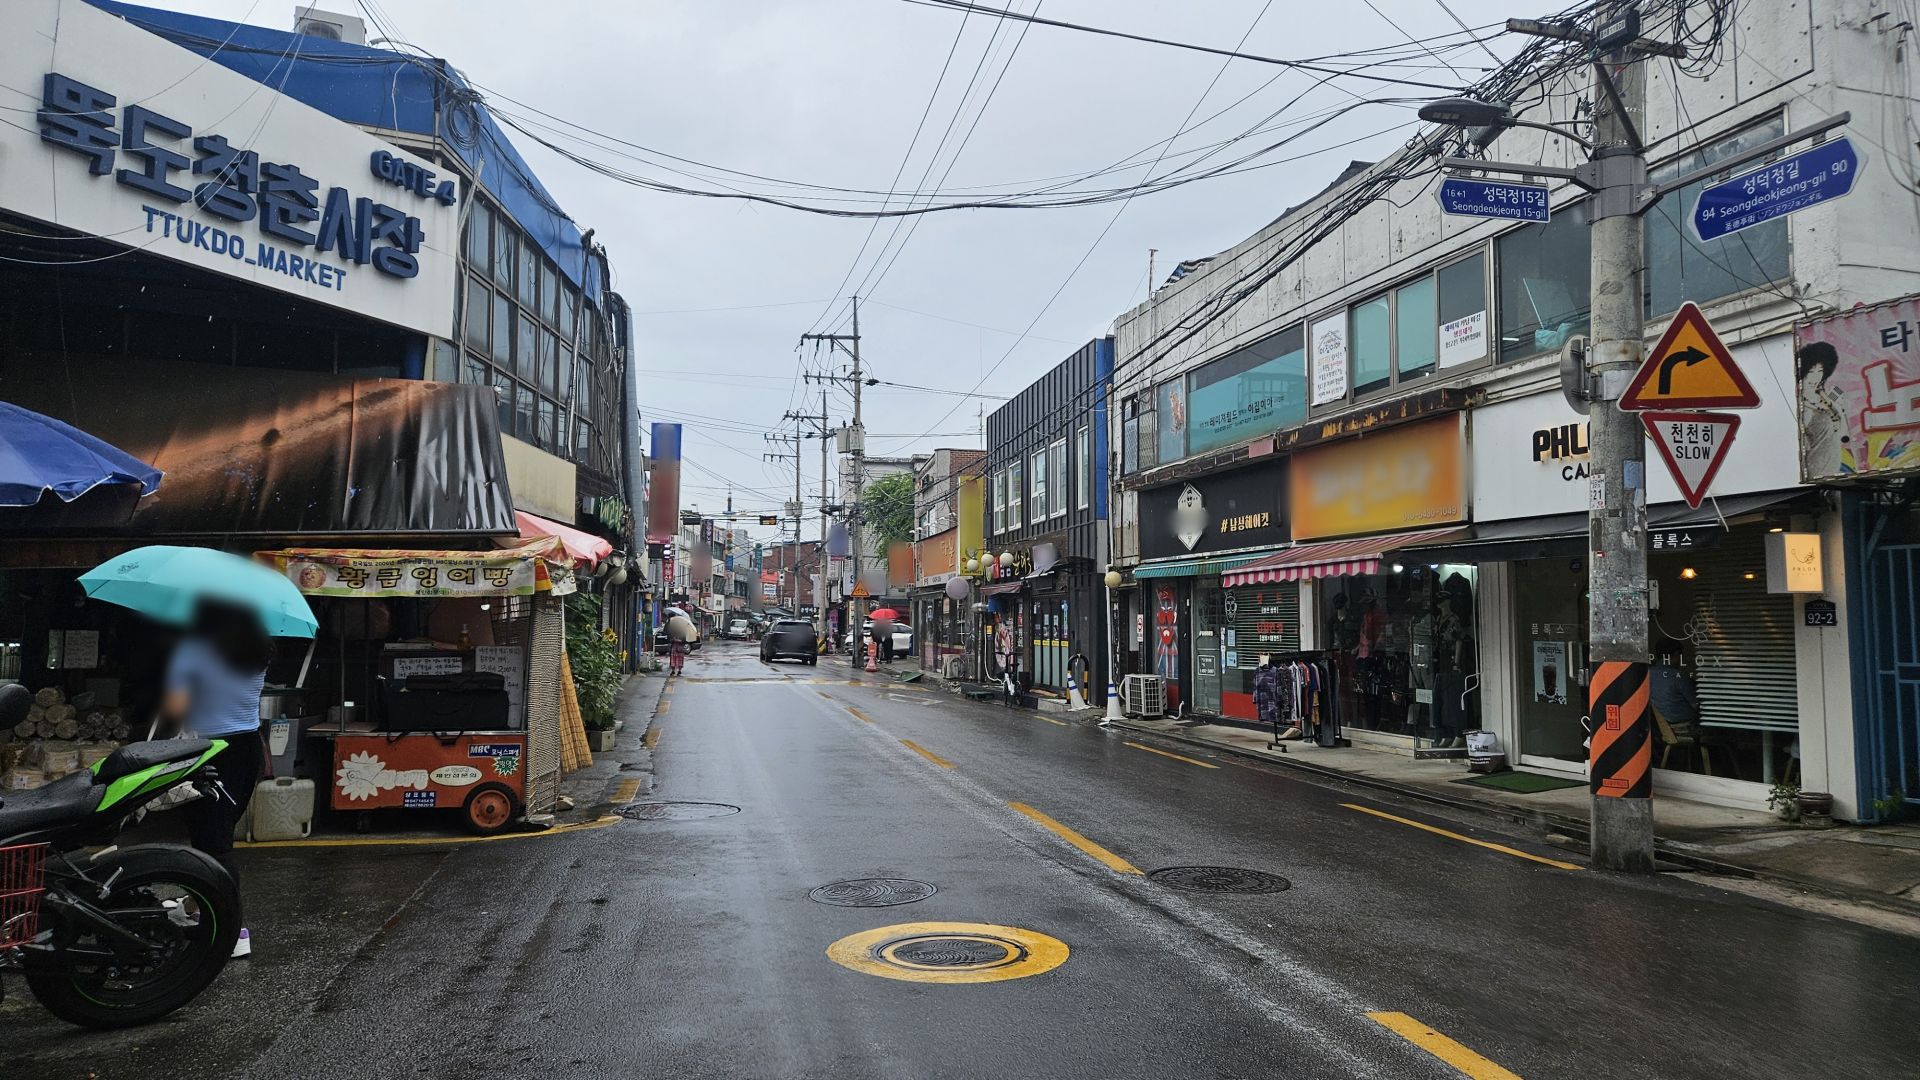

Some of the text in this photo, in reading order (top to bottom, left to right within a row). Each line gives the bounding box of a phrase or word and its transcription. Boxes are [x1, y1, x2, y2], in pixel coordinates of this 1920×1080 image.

[37, 73, 425, 279] 뚝도청춘시장
[371, 151, 457, 207] GATE 4
[1742, 159, 1800, 195] 성덕정길
[1483, 186, 1546, 207] 성덕정15길
[1702, 159, 1848, 222] 94 Seongdeokjeong-gil 90
[1452, 200, 1546, 219] Seongdeokjeong 15-gil
[142, 204, 347, 292] TTUKDO_MARKET
[1533, 420, 1591, 462] PHL
[1671, 422, 1714, 446] 천천히
[1675, 445, 1711, 460] SLOW
[1652, 532, 1693, 549] 플록스
[336, 565, 513, 590] 황금잉어빵
[1807, 612, 1833, 625] 92-2
[1648, 652, 1722, 668] PHLOX
[469, 745, 490, 754] MBC
